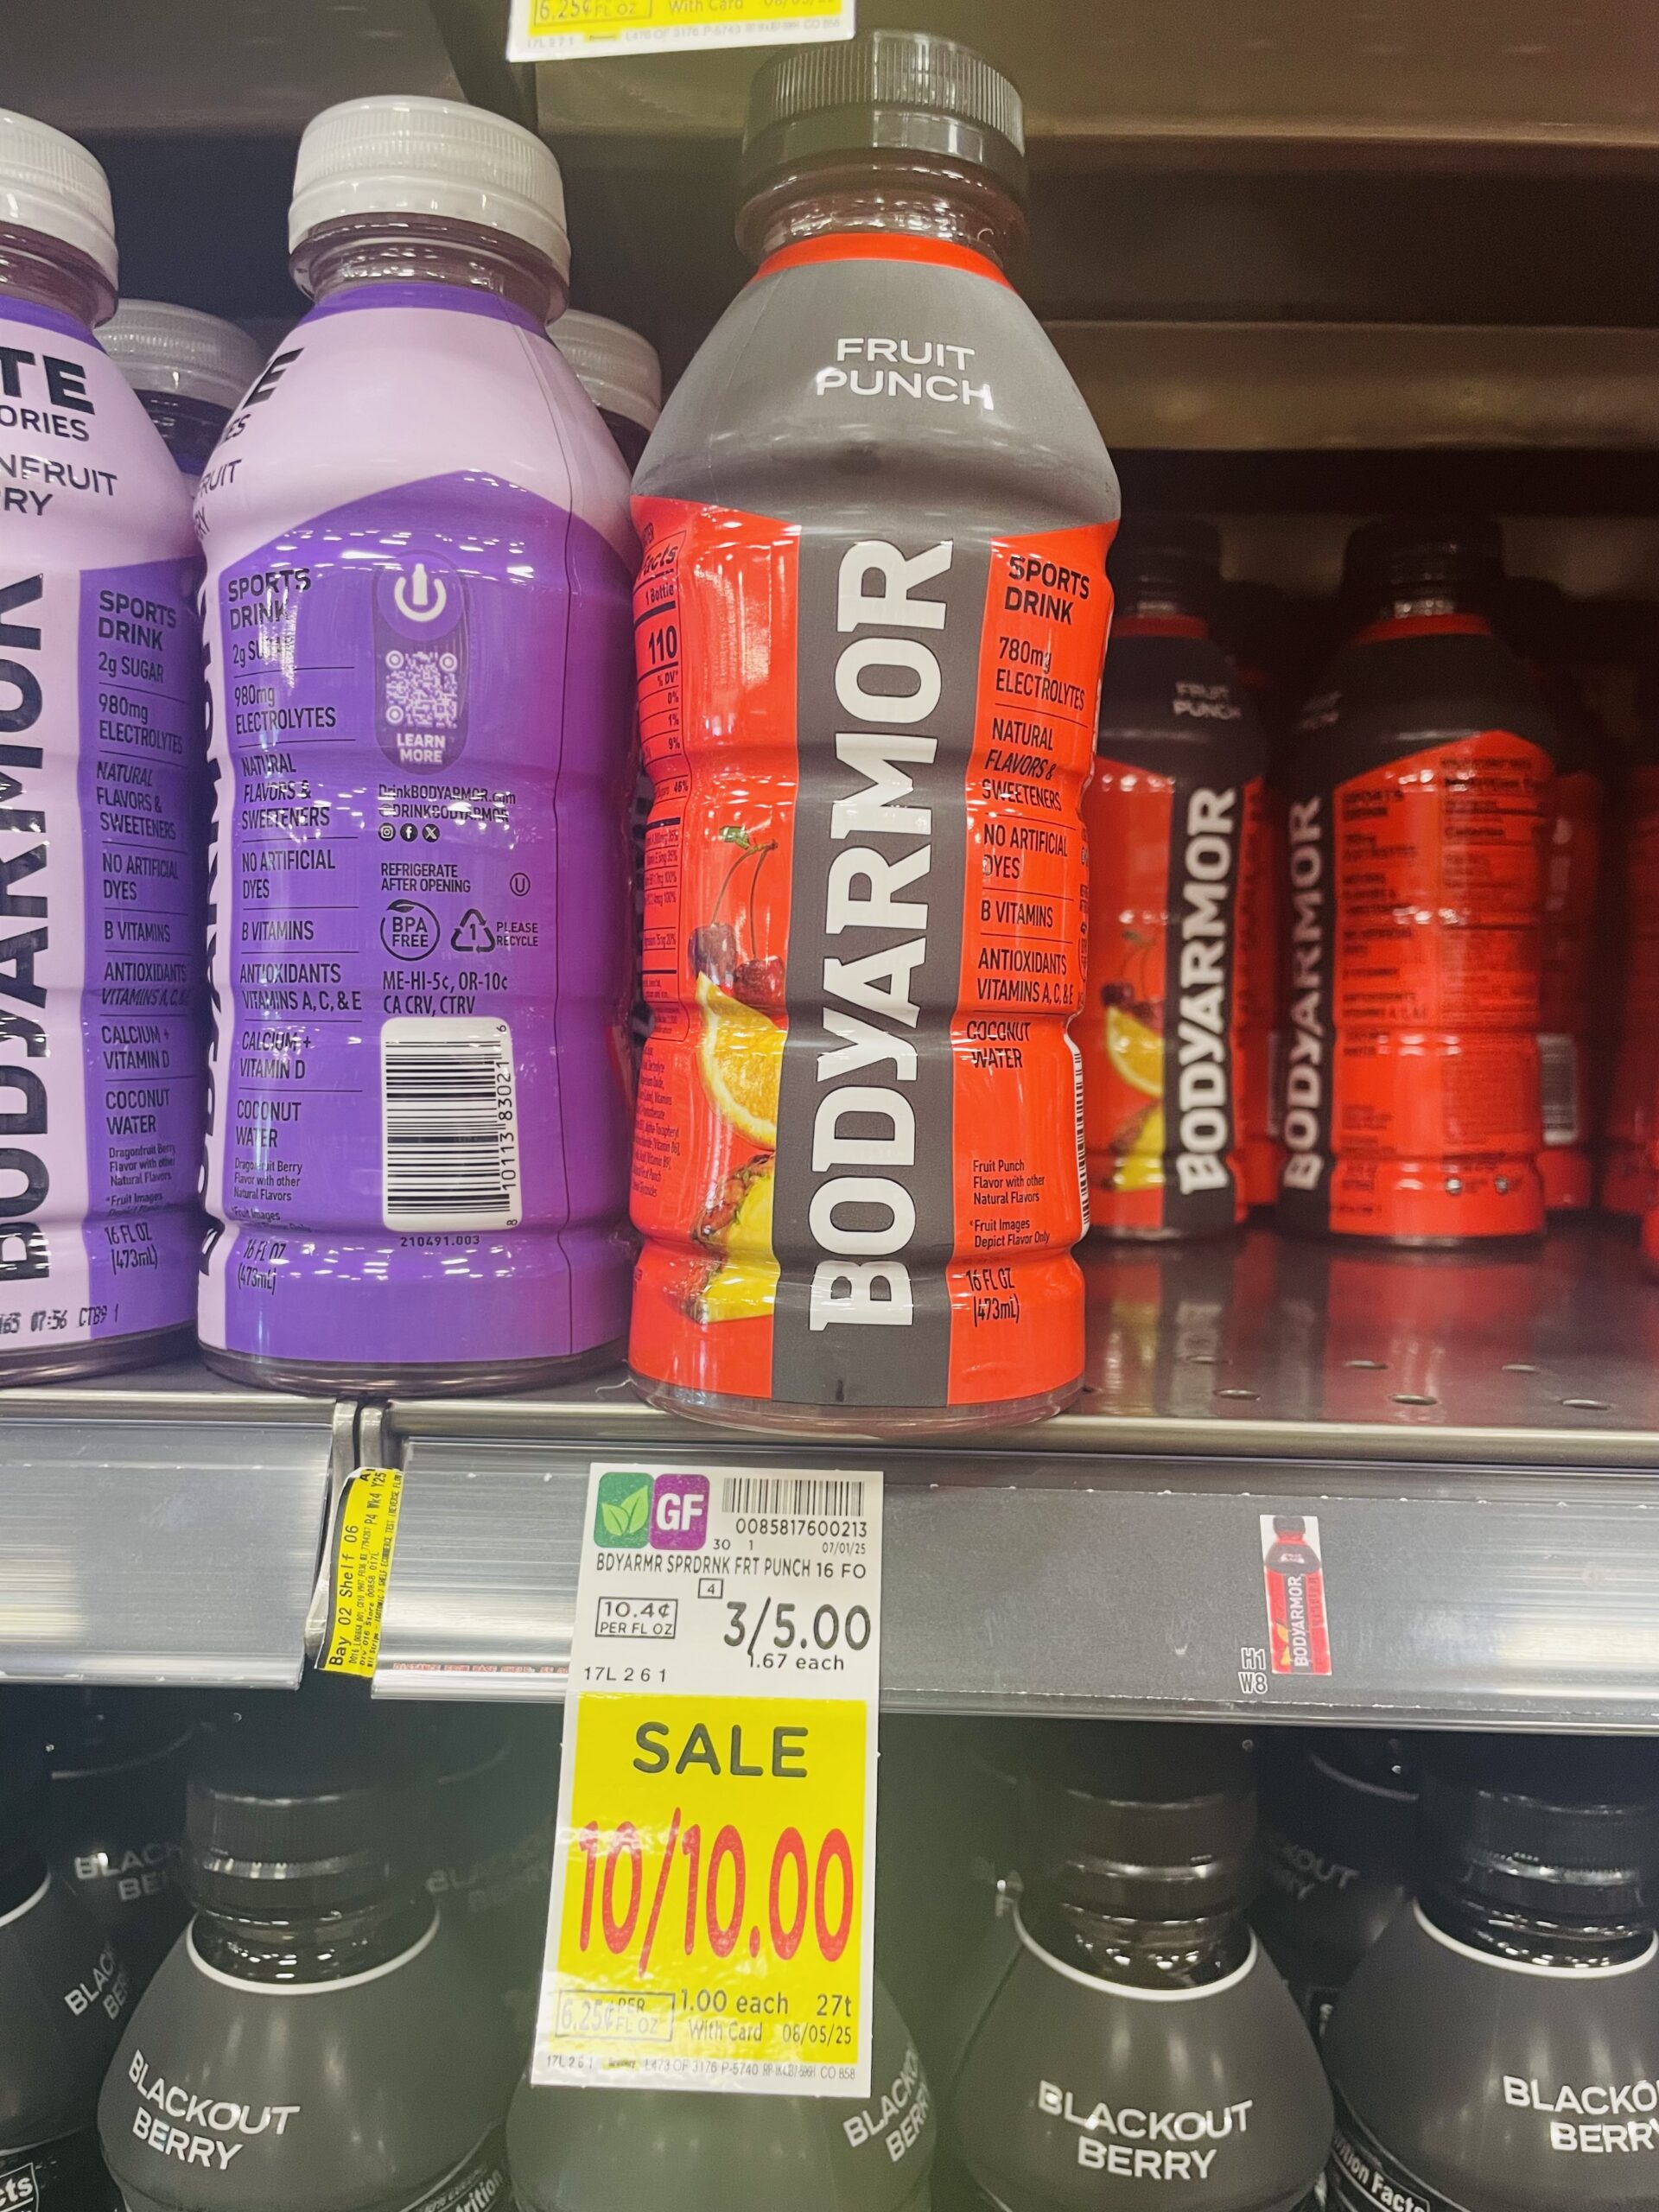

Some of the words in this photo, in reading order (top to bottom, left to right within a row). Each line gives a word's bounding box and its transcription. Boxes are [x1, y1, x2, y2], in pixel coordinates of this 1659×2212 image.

[836, 338, 976, 371] FRUIT
[816, 366, 994, 410] PUNCH
[228, 568, 311, 602] SPORTS
[1008, 556, 1090, 600] SPORTS
[99, 589, 177, 628] SPORTS
[1004, 586, 1074, 625] DRINK
[98, 617, 163, 652] DRINK
[648, 624, 678, 665] 110
[999, 636, 1052, 674] 780mg
[98, 651, 118, 678] 2g
[121, 659, 164, 683] SUGAR
[995, 669, 1085, 711] ELECTROLYTES
[98, 693, 149, 724] 980mg
[236, 706, 337, 734] ELECTROLYTES
[668, 712, 680, 727] 1%
[99, 720, 183, 754] ELECTROLYTES
[396, 733, 446, 749] LEARN
[668, 735, 681, 750] 9%
[993, 717, 1053, 752] NATURAL
[399, 748, 443, 764] MORE
[984, 748, 1048, 779] FLAVORS
[96, 761, 153, 787] NATURAL
[96, 786, 152, 811] FLAVORS
[982, 779, 1062, 812] SWEETENERS
[99, 811, 176, 841] SWEETENERS
[983, 823, 1006, 848] NO
[1009, 826, 1068, 857] ARTIFICIAL
[102, 852, 123, 874] NO
[126, 855, 179, 880] ARTIFICIAL
[242, 852, 257, 873] NO
[260, 849, 336, 872] ARTIFICIAL
[380, 862, 458, 878] REFRIGERATE
[982, 854, 1020, 880] DYES
[103, 880, 137, 900] DYES
[243, 879, 270, 899] DYES
[380, 878, 417, 892] AFTER
[420, 879, 471, 893] OPENING
[391, 916, 428, 932] BPA
[981, 899, 991, 922] B
[995, 900, 1053, 928] VITAMINS
[104, 920, 114, 940] B
[118, 921, 171, 943] VITAMINS
[241, 921, 249, 941] B
[251, 920, 315, 941] VITAMINS
[496, 921, 539, 933] PLEASE
[808, 537, 953, 1332] BODYARMOR
[391, 934, 429, 948] FREE
[496, 935, 539, 947] RECYCLE
[104, 962, 188, 982] ANTIOXIDANTS
[978, 947, 1067, 976] ANTIOXIDANTS
[101, 988, 159, 1007] VITAMINS
[319, 990, 334, 1013] C,
[353, 990, 362, 1010] E
[976, 977, 1039, 1003] VITAMINS
[1176, 787, 1237, 1195] BODYARMOR
[383, 995, 402, 1014] CA
[404, 995, 436, 1017] CRV,
[440, 995, 475, 1014] CTRV
[101, 1026, 161, 1045] CALCIUM
[966, 1020, 1031, 1042] COCONUT
[104, 1050, 160, 1070] VITAMIN
[295, 1058, 306, 1079] D
[972, 1047, 1023, 1069] WATER
[105, 1088, 171, 1109] COCONUT
[237, 1099, 302, 1122] COCONUT
[106, 1116, 156, 1135] WATER
[277, 1160, 302, 1176] Berry
[499, 1131, 517, 1191] 10113
[972, 1160, 995, 1173] Fruit
[998, 1159, 1025, 1172] Punch
[110, 1174, 143, 1187] Natural
[234, 1172, 255, 1186] Flavor
[276, 1175, 301, 1187] other
[973, 1176, 1003, 1189] Flavor
[1005, 1175, 1025, 1188] with
[1027, 1174, 1046, 1186] other
[233, 1186, 259, 1200] Natural
[260, 1188, 292, 1202] Flavors
[973, 1192, 1009, 1205] Natural
[1010, 1191, 1040, 1204] Flavors
[105, 1223, 120, 1245] 16
[136, 1222, 153, 1243] OZ
[999, 1217, 1031, 1233] Images
[400, 1236, 480, 1248] 210491.003
[975, 1234, 1005, 1249] Depict
[1007, 1232, 1033, 1245] Flavor
[1033, 1230, 1051, 1246] Only
[111, 1244, 159, 1275] (473mL)
[982, 1269, 998, 1291] FL
[656, 1492, 705, 1531] GF
[343, 1524, 359, 1543] 06
[735, 1518, 868, 1538] 0085817600213
[713, 1539, 731, 1551] 30
[822, 1541, 867, 1555] 07/01/25
[339, 1553, 355, 1598] Shelf
[596, 1552, 663, 1573] BDYARMR
[666, 1554, 730, 1575] SPRDRNK
[734, 1556, 759, 1576] FRT
[764, 1557, 810, 1578] PUNCH
[817, 1562, 834, 1578] 16
[842, 1564, 867, 1580] FO
[338, 1607, 353, 1626] 02
[603, 1601, 671, 1619] 10.4¢
[1287, 1575, 1309, 1667] BODYARMOR
[600, 1621, 626, 1634] PER
[632, 1622, 648, 1635] FL
[652, 1623, 673, 1636] OZ
[723, 1597, 871, 1656] 3/5.00
[329, 1636, 352, 1666] Bay
[747, 1652, 788, 1669] 1.67
[795, 1655, 845, 1671] each
[583, 1667, 617, 1681] 17L
[632, 1720, 809, 1778] SALE
[578, 1806, 855, 1978] 10/10.00
[680, 1988, 728, 2012] 1.00
[736, 1992, 789, 2015] each
[817, 1993, 852, 2018] 27t
[689, 2018, 723, 2041] With
[728, 2021, 763, 2043] Card
[820, 2066, 836, 2079] CO
[129, 2049, 301, 2134] BLACKOUT
[1503, 2075, 1659, 2115] BLACKO
[1038, 2079, 1254, 2141] BLACKOUT
[132, 2106, 245, 2170] BERRY
[1078, 2135, 1217, 2180] BERRY
